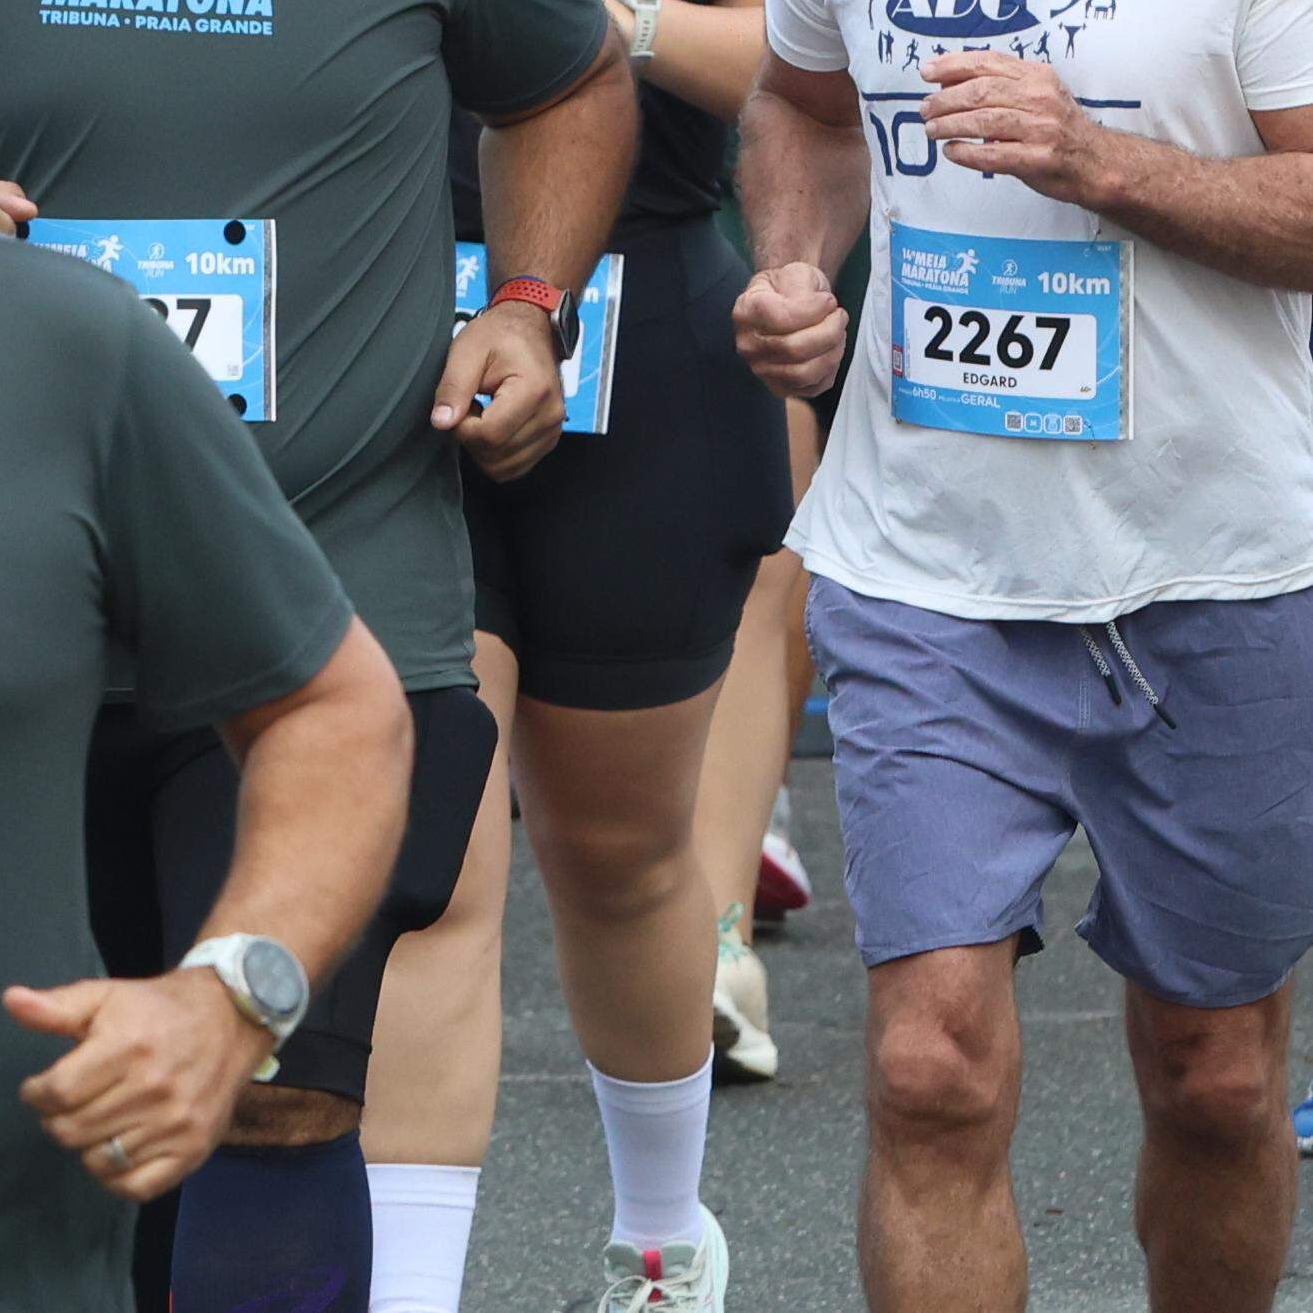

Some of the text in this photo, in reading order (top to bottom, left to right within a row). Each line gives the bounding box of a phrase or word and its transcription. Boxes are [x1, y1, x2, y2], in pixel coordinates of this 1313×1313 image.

[39, 10, 273, 36] TRIBUNA PRAIA GRANDE
[185, 251, 255, 275] 10km
[901, 263, 969, 287] MARATONA
[1038, 271, 1111, 295] 10km
[924, 305, 1071, 371] 2267
[963, 372, 1018, 388] EDGARD
[912, 386, 937, 401] 6h50
[961, 393, 1001, 408] GERAL
